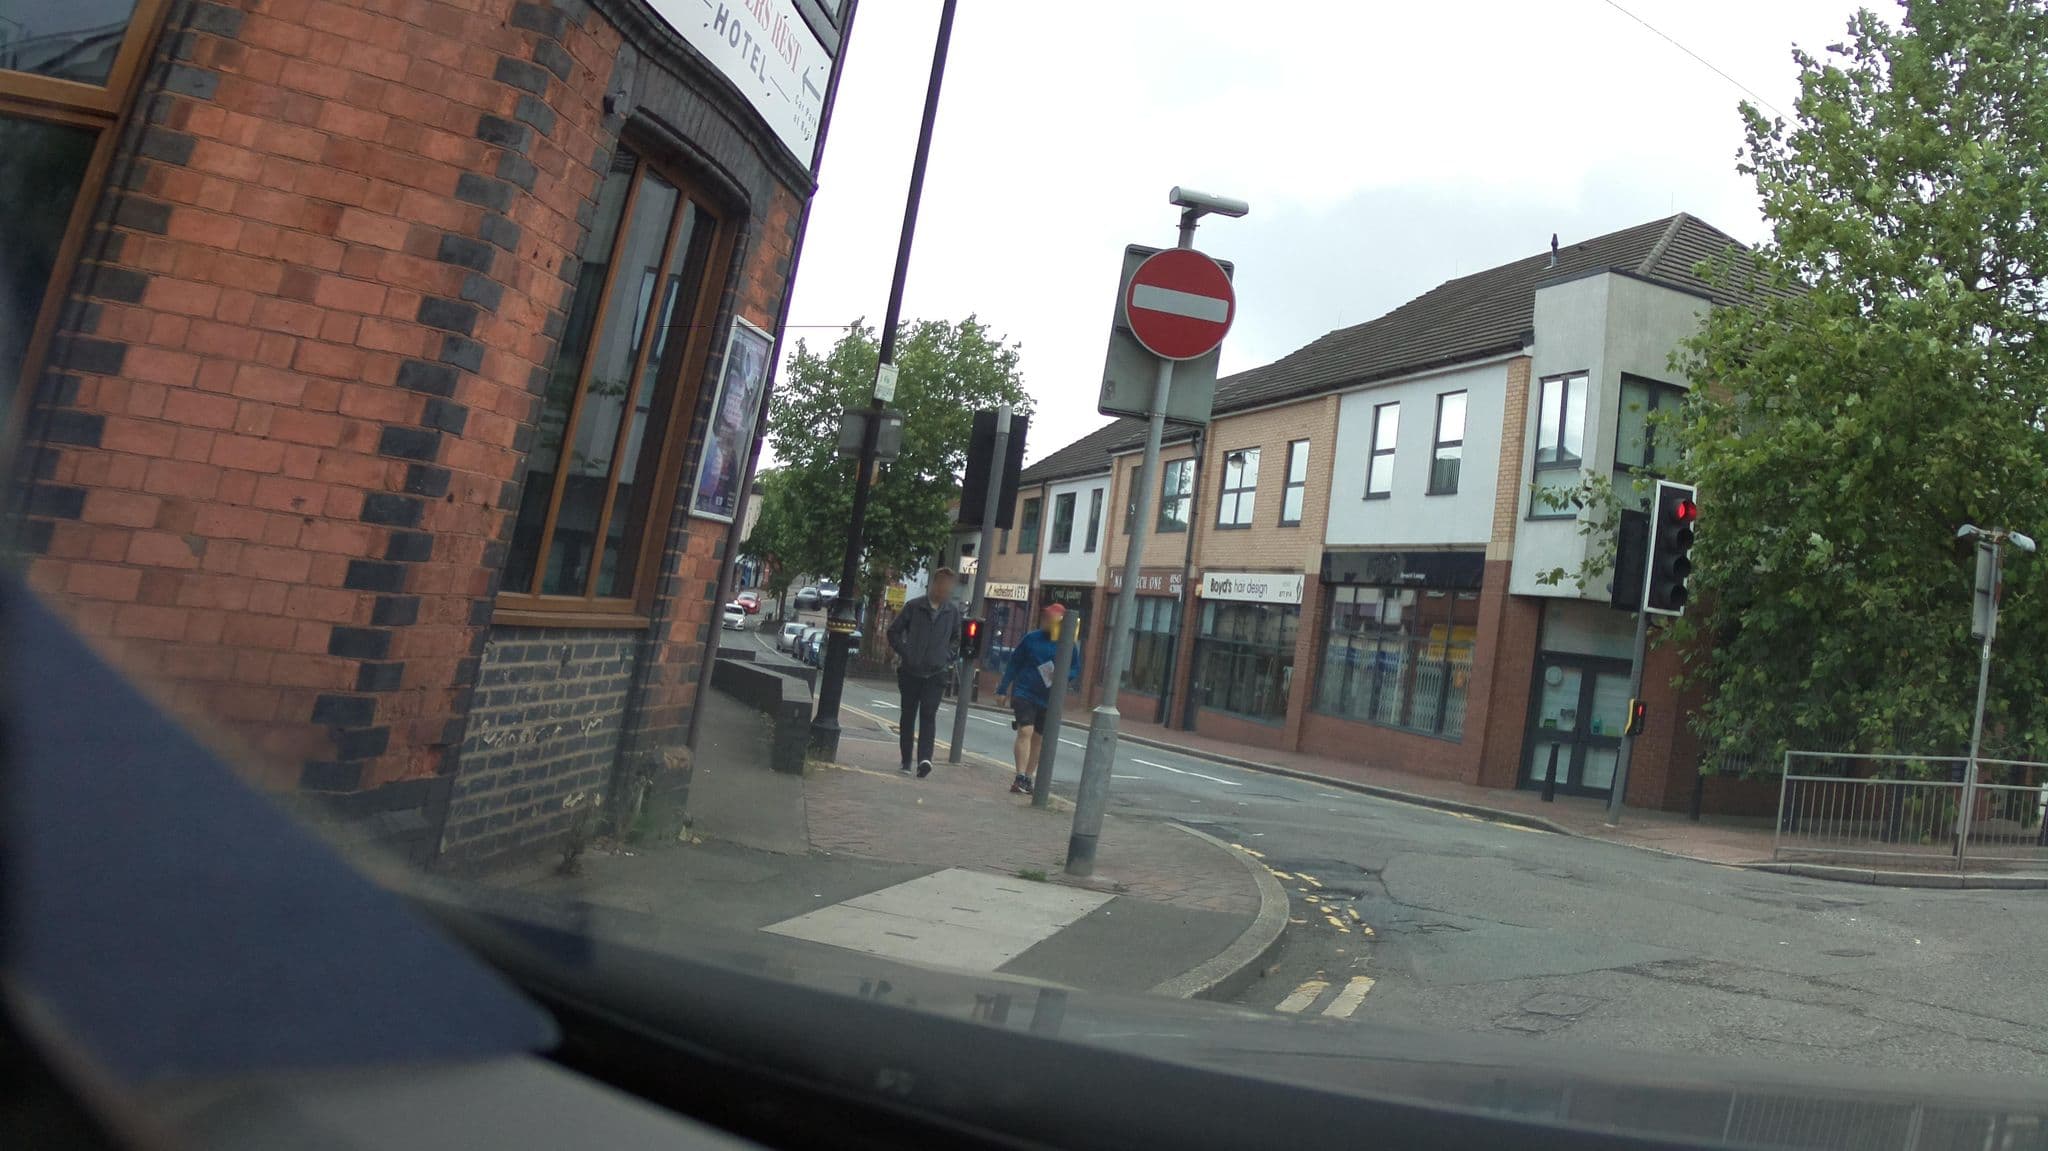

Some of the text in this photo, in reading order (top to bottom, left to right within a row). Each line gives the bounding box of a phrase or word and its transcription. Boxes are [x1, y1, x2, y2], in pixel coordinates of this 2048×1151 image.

[713, 2, 766, 84] HOTEL
[771, 11, 802, 73] REST
[1149, 576, 1162, 590] ONE
[1210, 578, 1268, 598] Boyd's hair design
